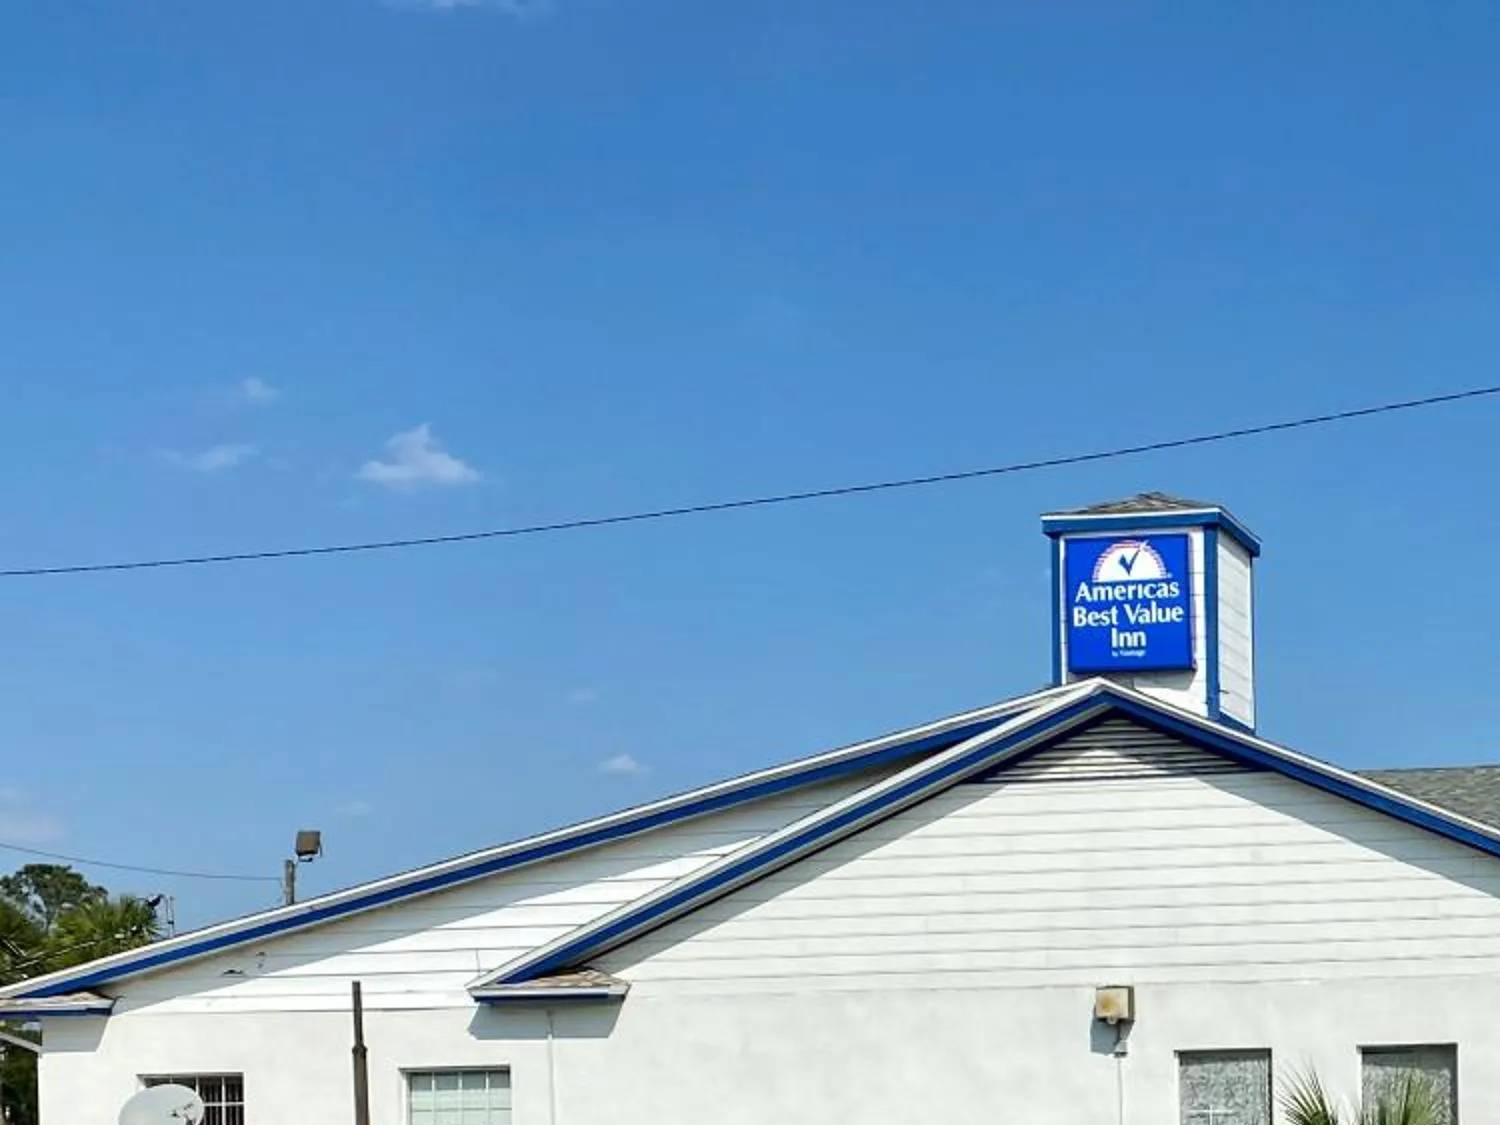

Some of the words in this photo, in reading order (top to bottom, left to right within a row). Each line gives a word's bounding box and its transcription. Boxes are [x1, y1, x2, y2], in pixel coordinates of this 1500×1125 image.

[1075, 582, 1180, 602] Americas
[1073, 605, 1119, 627] Best
[1123, 601, 1184, 625] Value
[1111, 628, 1147, 648] Inn
